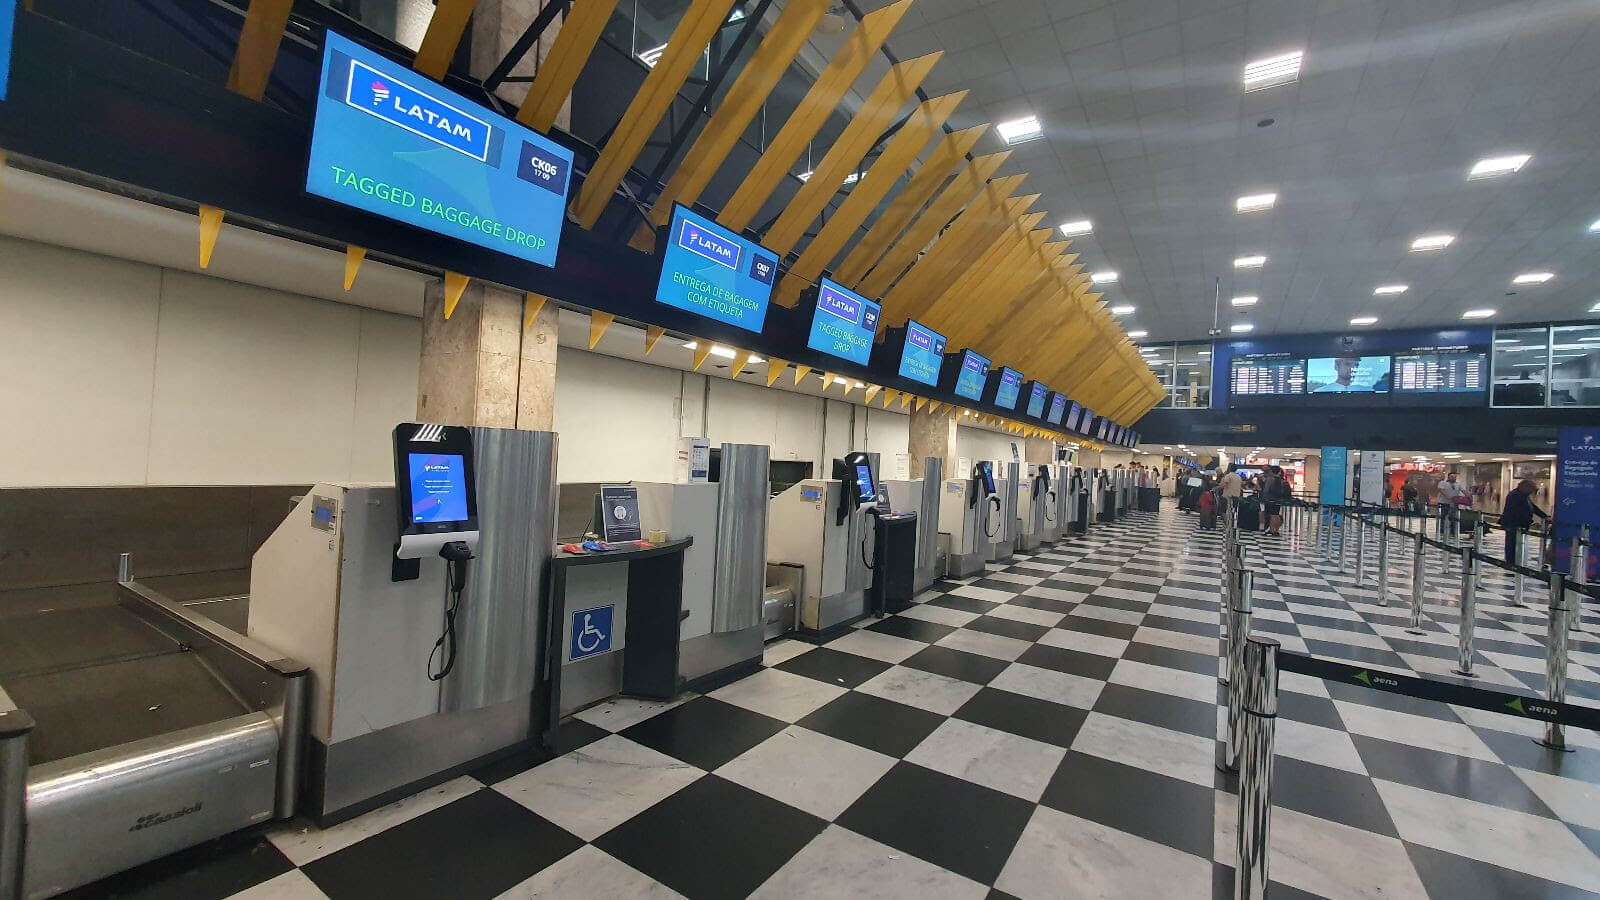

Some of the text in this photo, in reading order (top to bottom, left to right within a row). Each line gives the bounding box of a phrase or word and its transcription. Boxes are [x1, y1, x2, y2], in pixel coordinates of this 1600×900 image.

[394, 95, 472, 142] LATAM
[531, 156, 558, 176] CK06
[331, 165, 546, 251] TAGGED BAGGAGE DROP
[698, 236, 732, 259] LATAM
[673, 271, 760, 312] ENTREGA DE BAGAGEM
[687, 291, 744, 320] COM ETIQUETA
[831, 297, 855, 315] LATAM
[1373, 675, 1398, 687] aena
